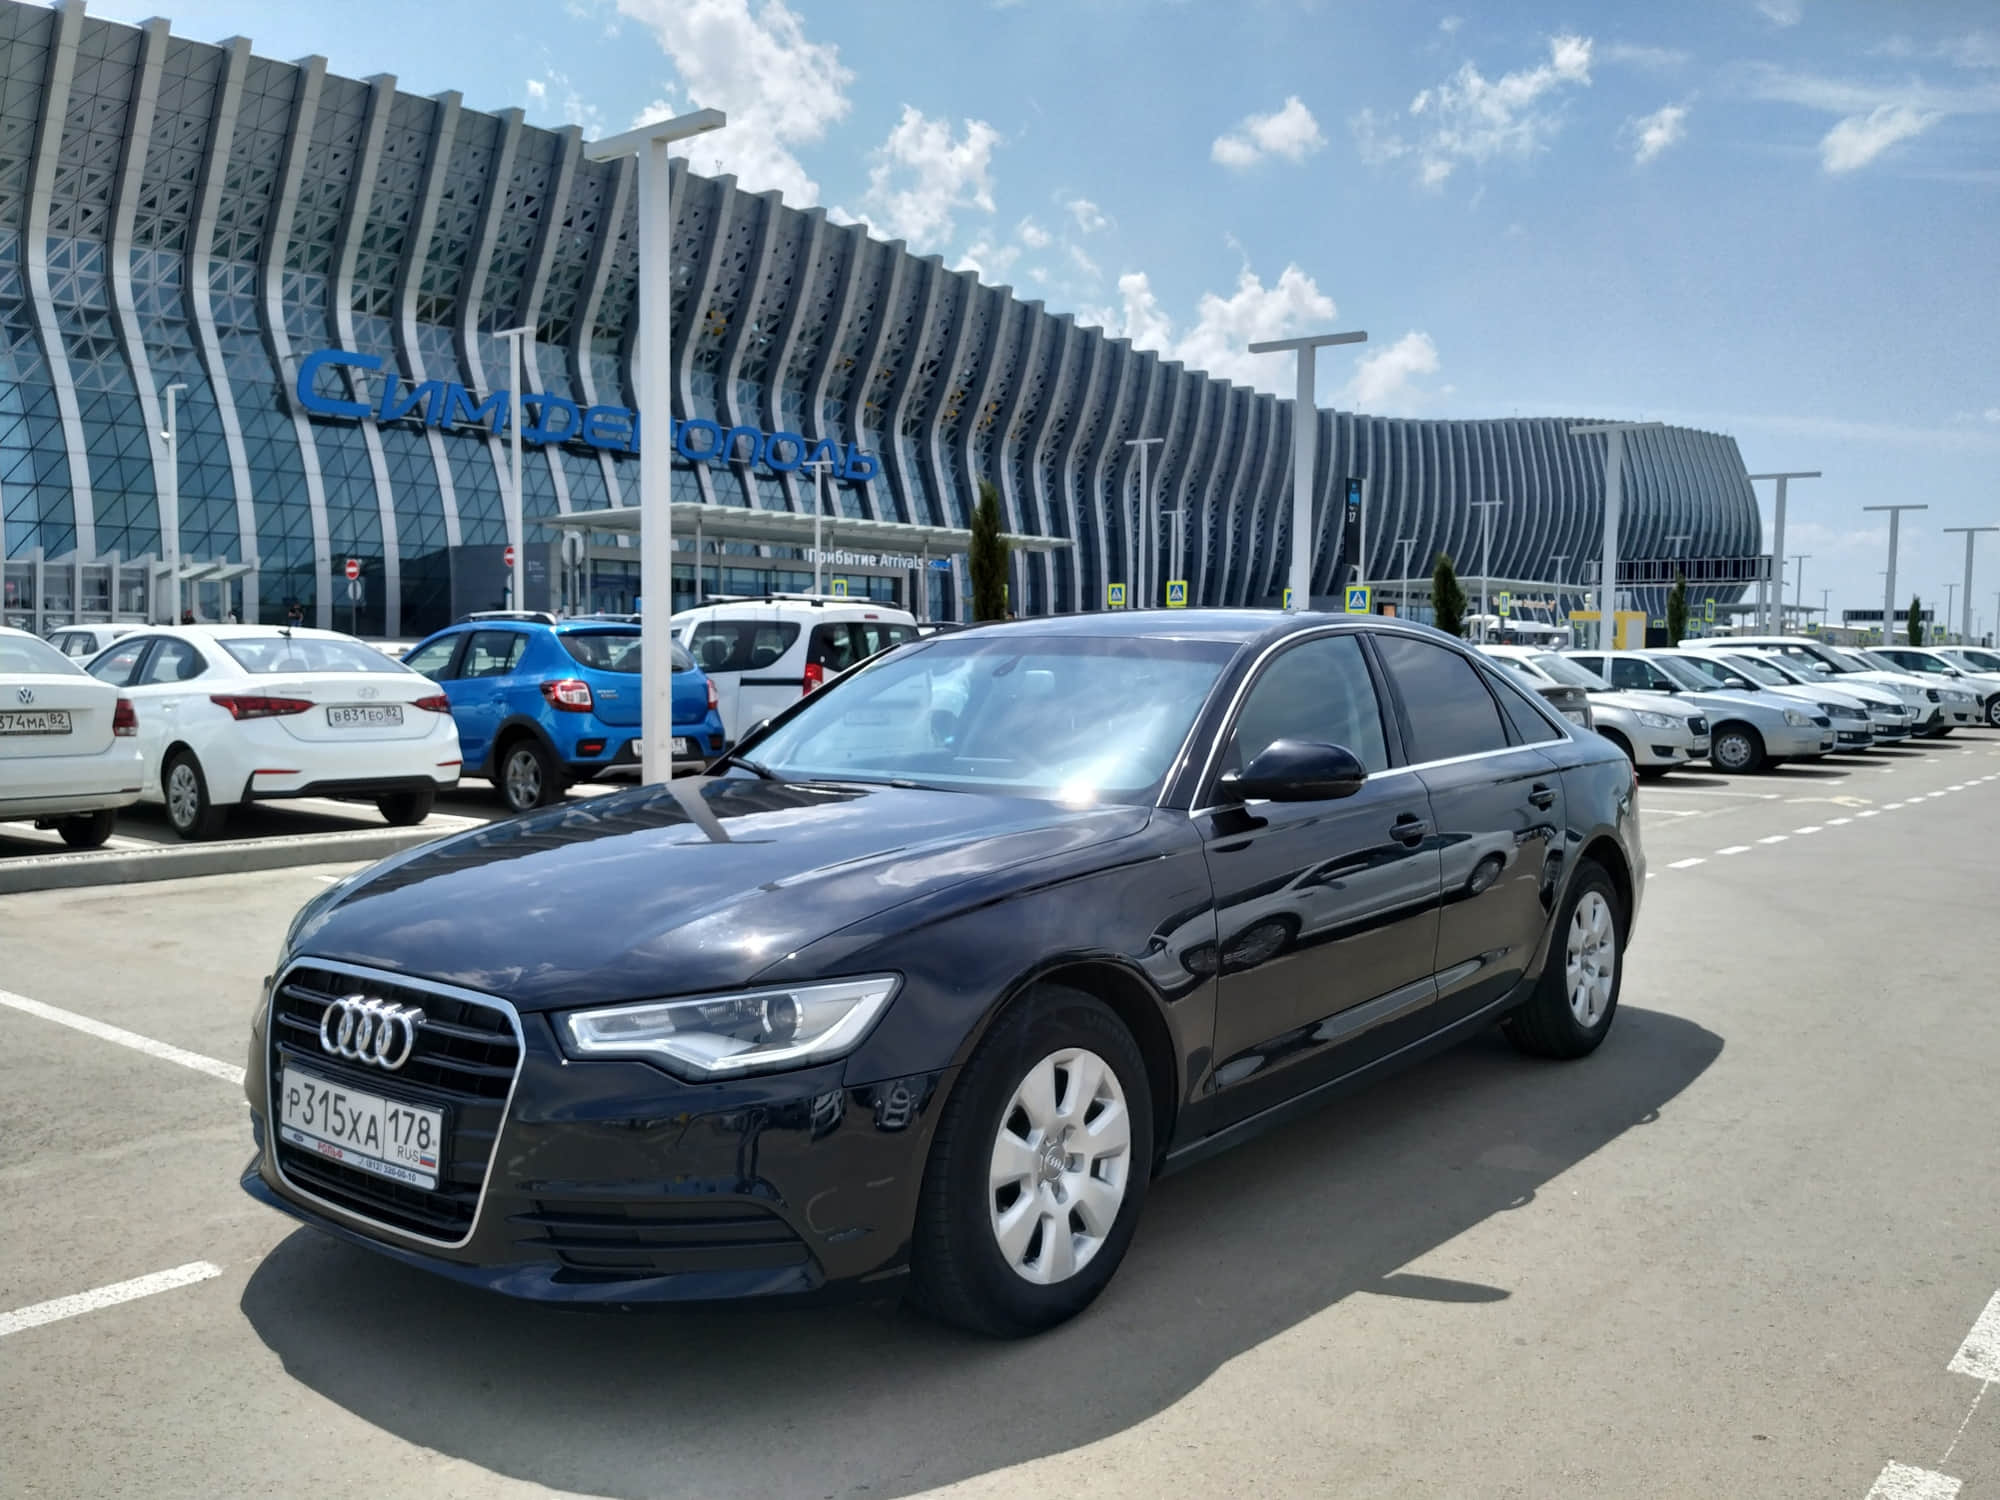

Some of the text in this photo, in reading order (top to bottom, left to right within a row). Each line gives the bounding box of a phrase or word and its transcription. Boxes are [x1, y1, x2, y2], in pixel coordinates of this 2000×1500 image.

[808, 548, 877, 567] Прибытие
[880, 553, 924, 569] Arrivals
[49, 713, 65, 725] 82
[388, 1108, 431, 1149] 178
[397, 1145, 419, 1163] RUS
